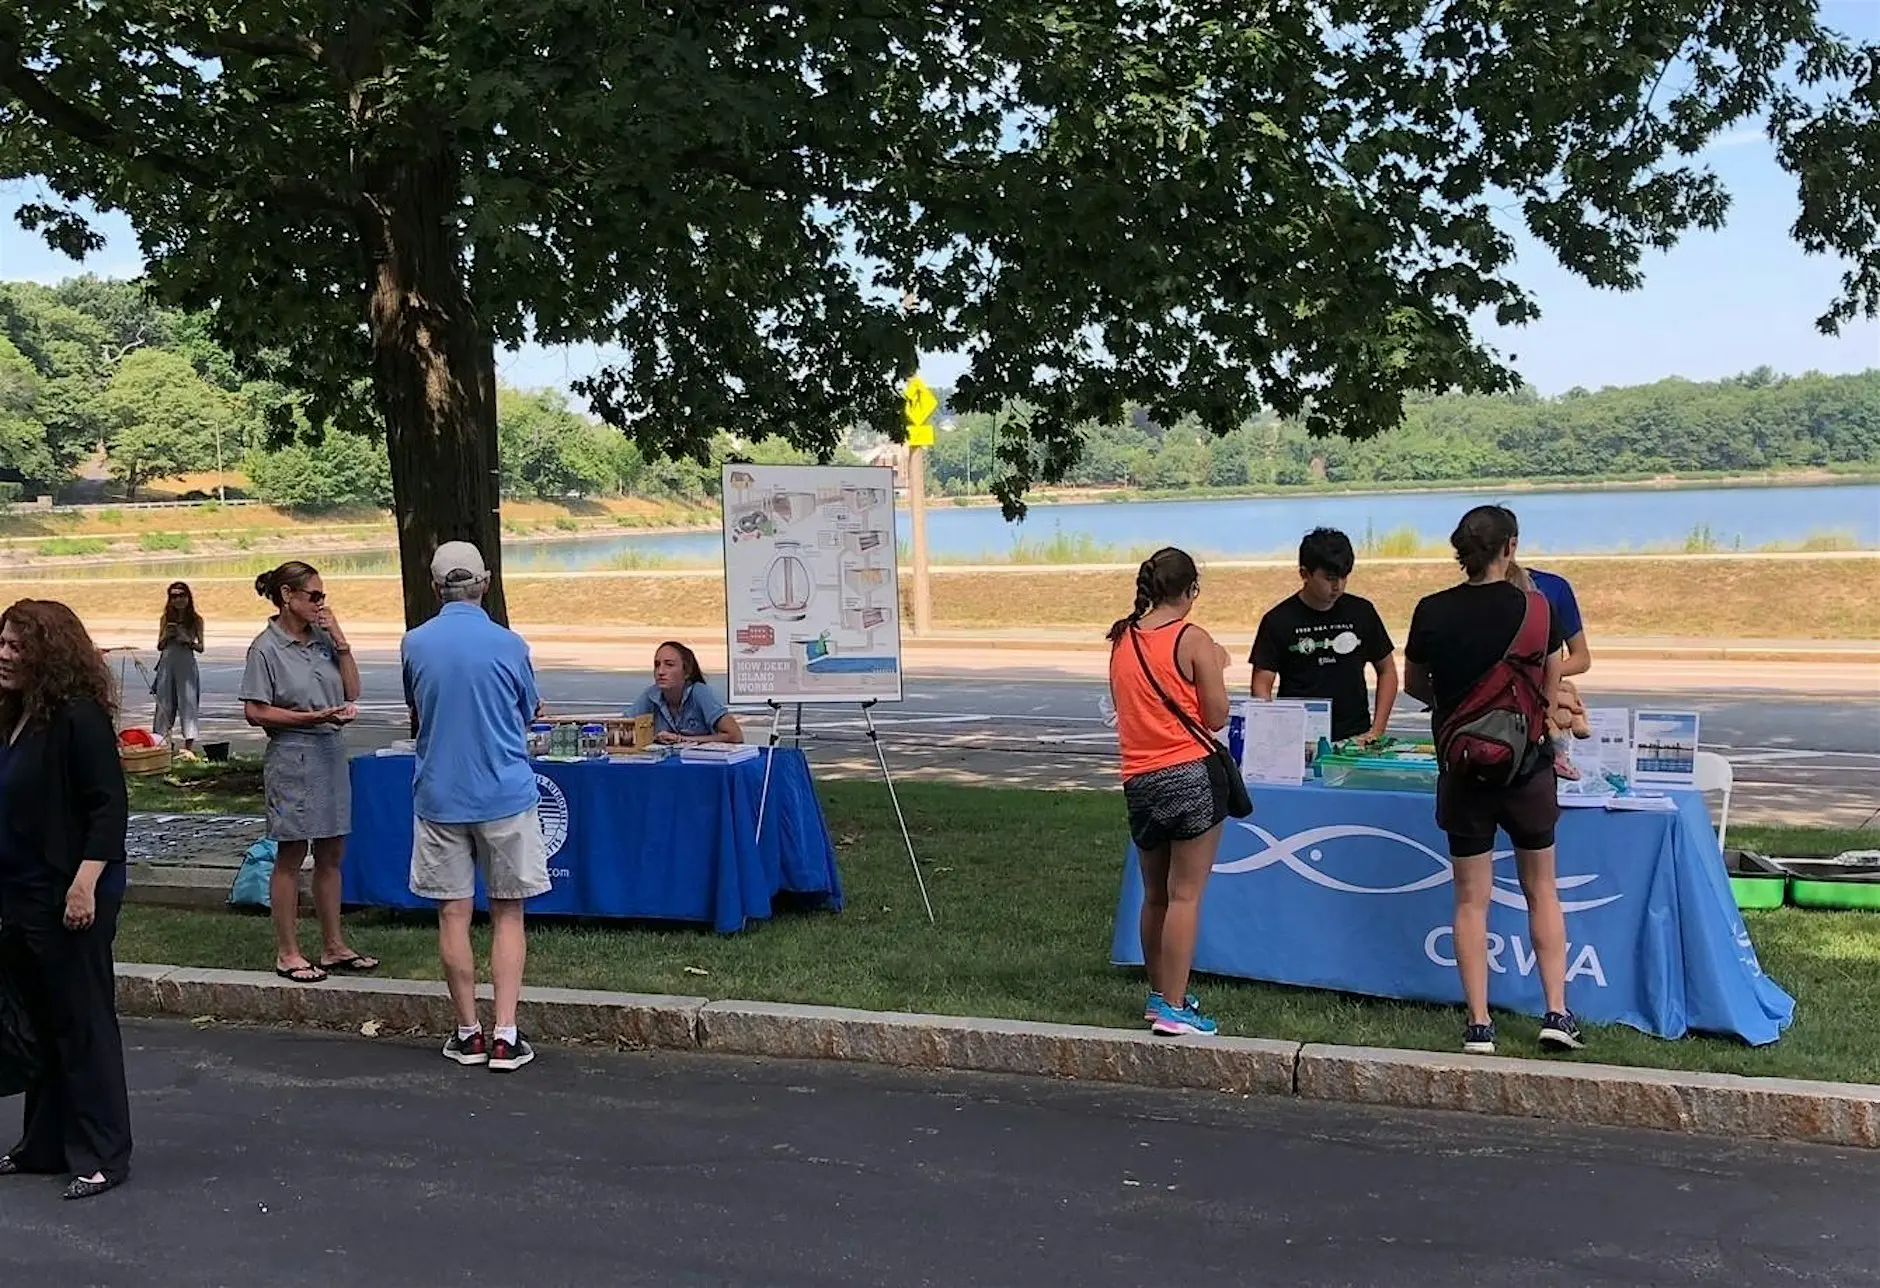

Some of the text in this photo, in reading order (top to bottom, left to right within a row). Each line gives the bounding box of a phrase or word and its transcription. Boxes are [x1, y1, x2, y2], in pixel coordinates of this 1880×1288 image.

[736, 661, 791, 671] HOW DEER
[737, 672, 774, 681] ISLAND
[737, 682, 774, 692] WORKS
